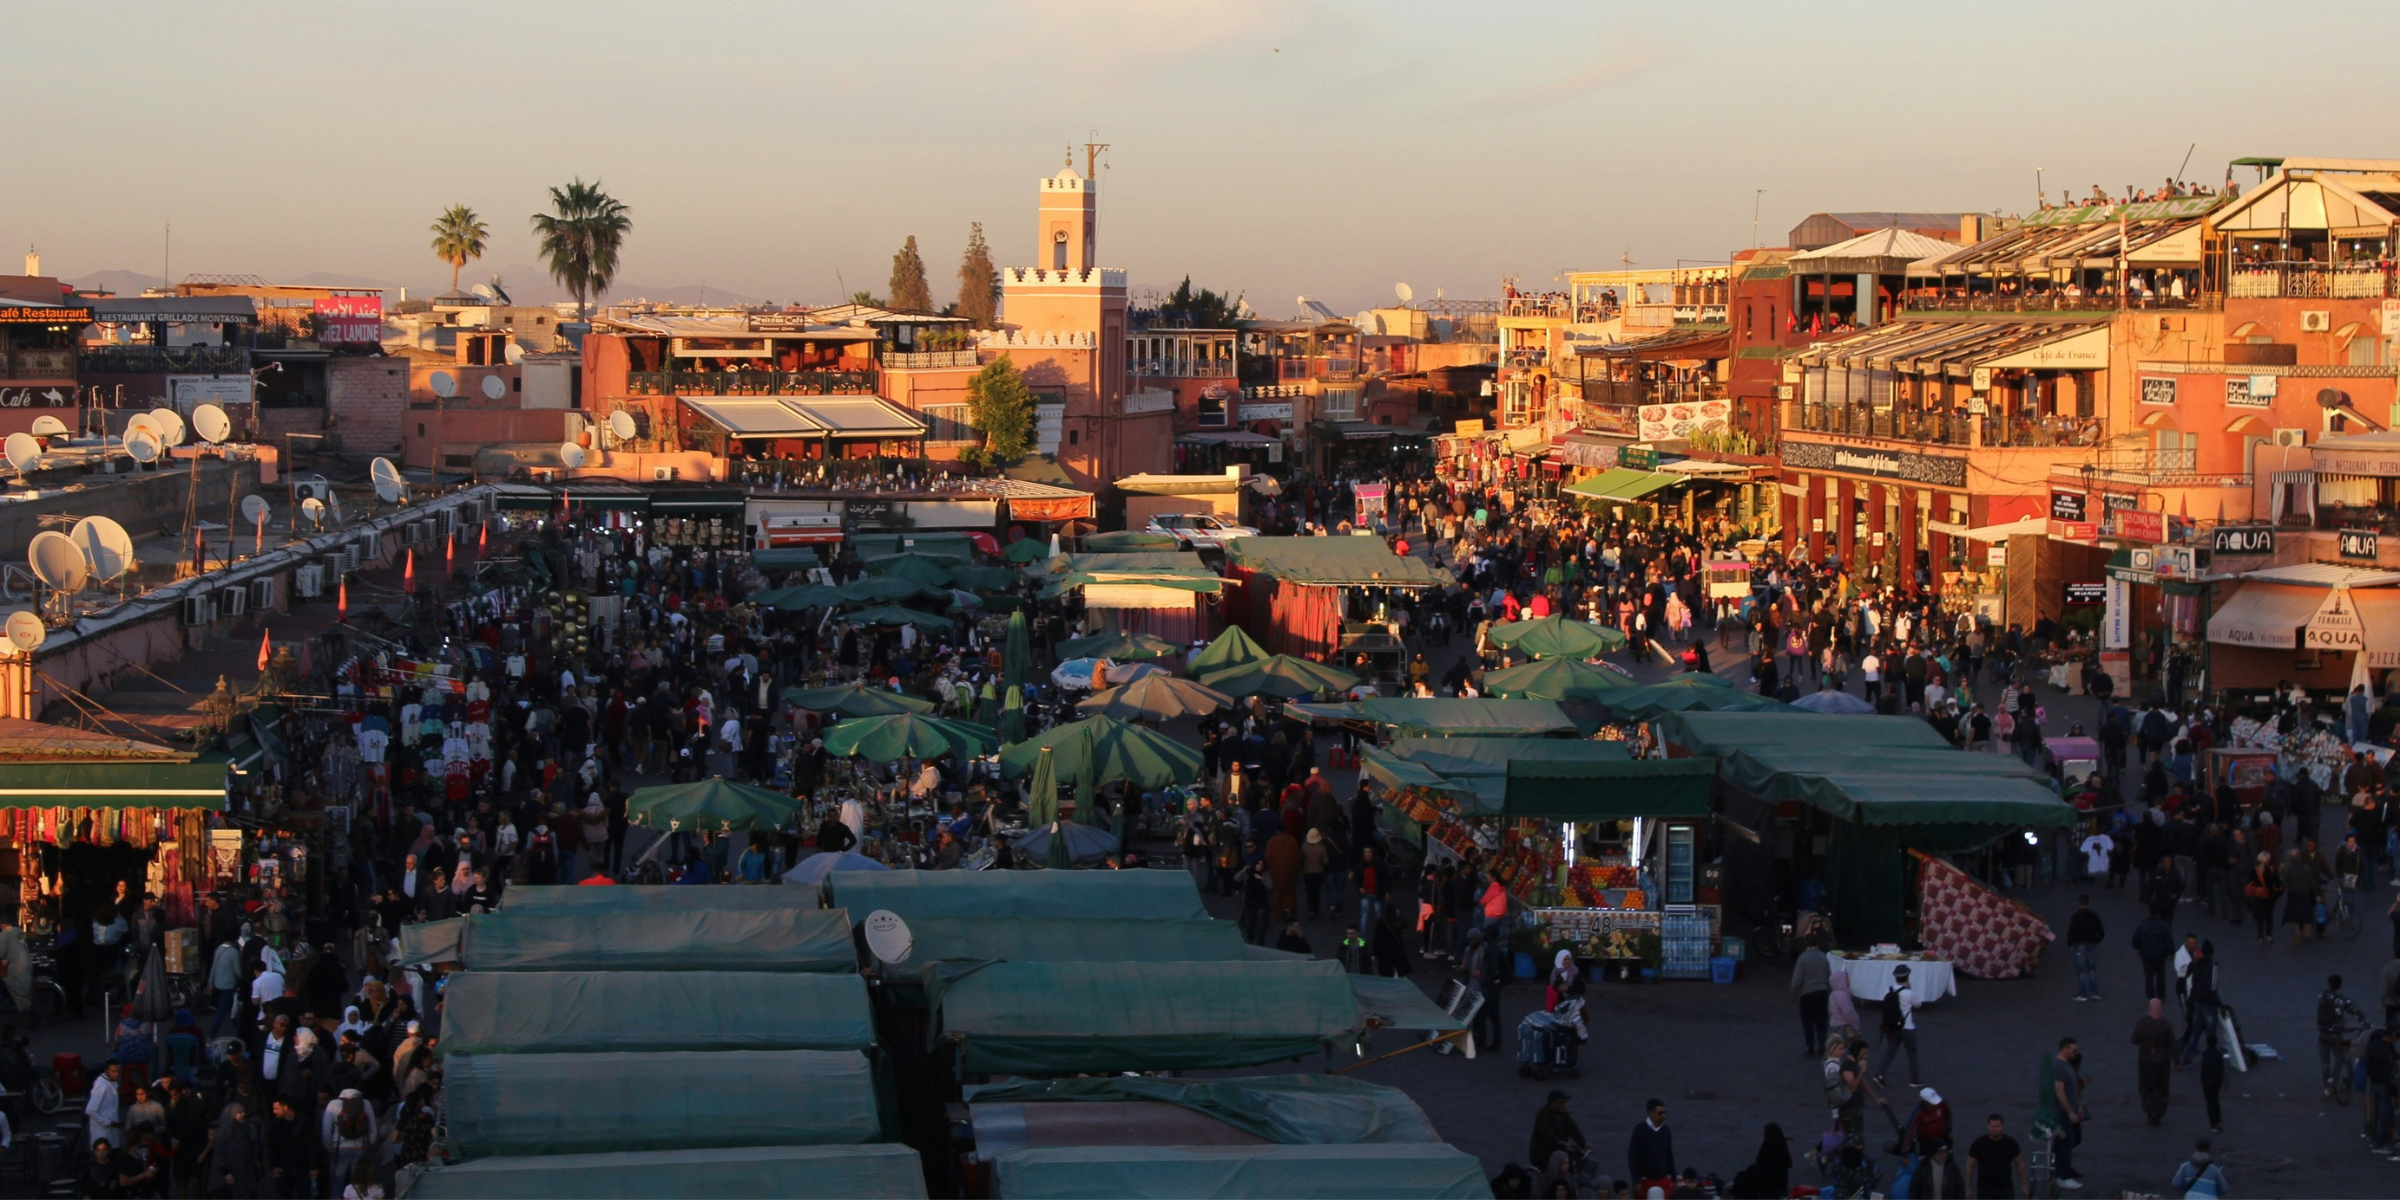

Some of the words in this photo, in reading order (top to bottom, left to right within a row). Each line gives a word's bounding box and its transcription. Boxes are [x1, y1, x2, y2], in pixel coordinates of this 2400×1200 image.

[2127, 196, 2217, 219] FRANCE
[0, 308, 19, 318] afé
[22, 308, 88, 318] Restaurant
[102, 313, 156, 321] RESTAURANT
[157, 313, 199, 322] GRILLADE
[200, 314, 248, 324] MONTASSIR
[343, 324, 379, 341] LAMINE
[2033, 351, 2053, 360] Café
[2068, 351, 2097, 359] France
[0, 387, 31, 407] Café
[2124, 512, 2133, 524] LES
[2133, 513, 2149, 528] CINQ
[2149, 515, 2162, 528] SENS
[2142, 530, 2161, 540] CENTER
[2216, 531, 2271, 550] AQUA
[2340, 534, 2375, 556] AQUA
[2317, 615, 2352, 625] TERRASSE
[2228, 629, 2254, 642] AQUA
[2307, 630, 2361, 645] AQUA
[1590, 916, 1612, 936] 48
